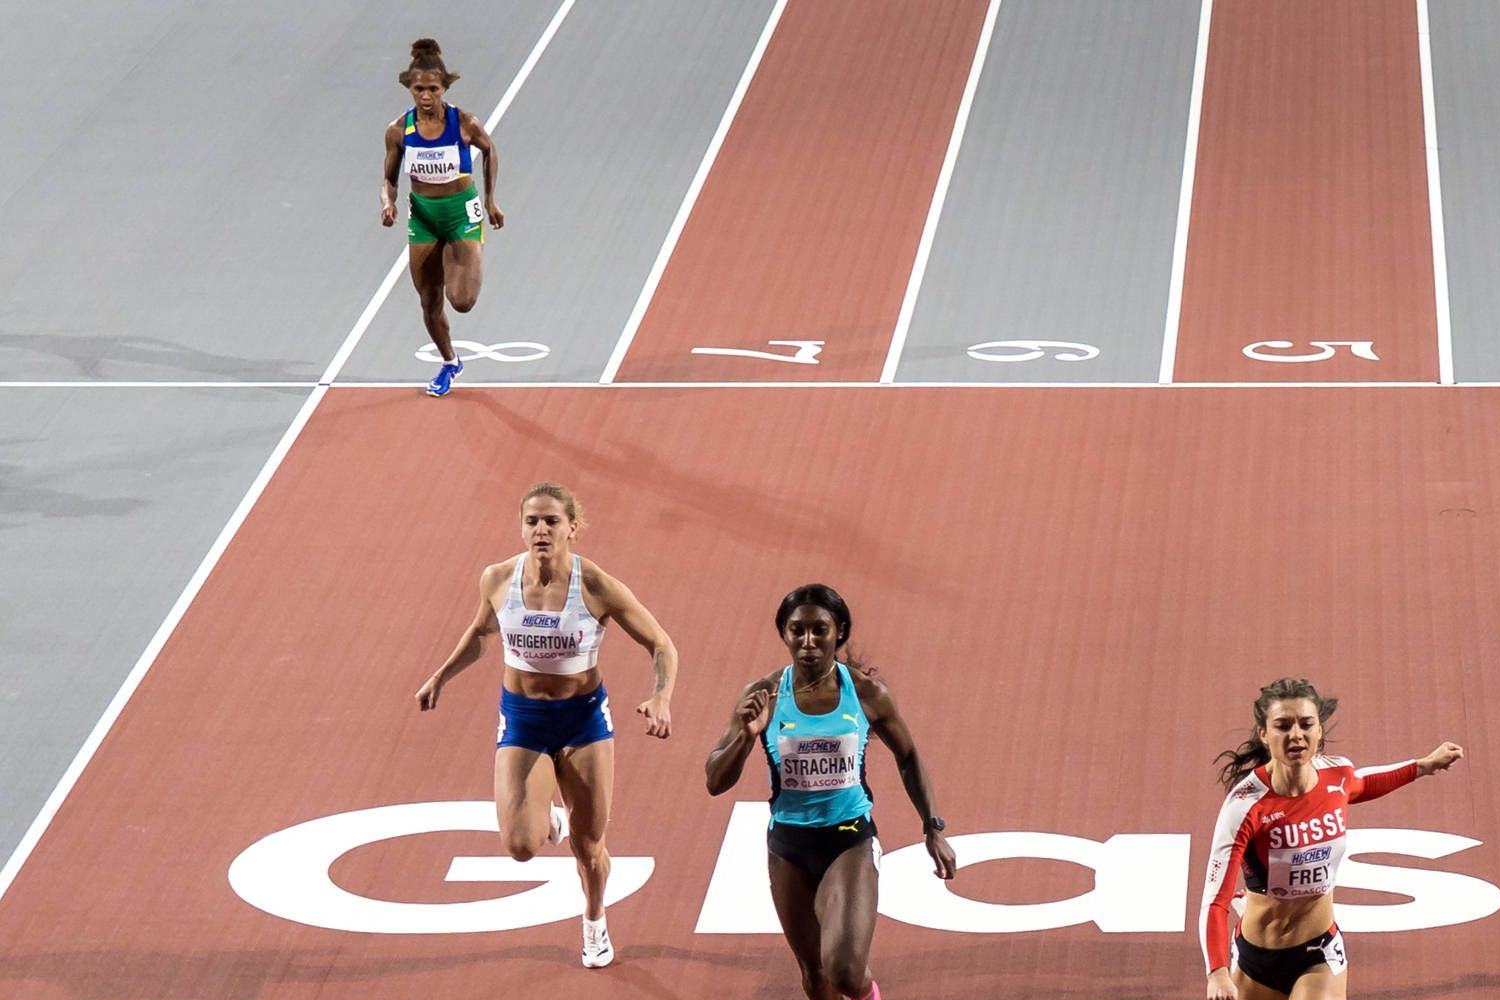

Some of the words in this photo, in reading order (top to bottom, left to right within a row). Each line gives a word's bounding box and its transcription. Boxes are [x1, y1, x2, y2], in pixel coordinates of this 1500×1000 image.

[410, 162, 455, 175] ARUNIA
[415, 340, 550, 363] 8
[691, 340, 825, 365] 7
[966, 340, 1101, 363] 6
[1242, 340, 1379, 362] 5
[507, 632, 577, 649] WEIGERTOVÁ
[784, 755, 855, 776] STRACHAN
[800, 778, 847, 788] GLASGOW
[1288, 864, 1331, 886] FREY
